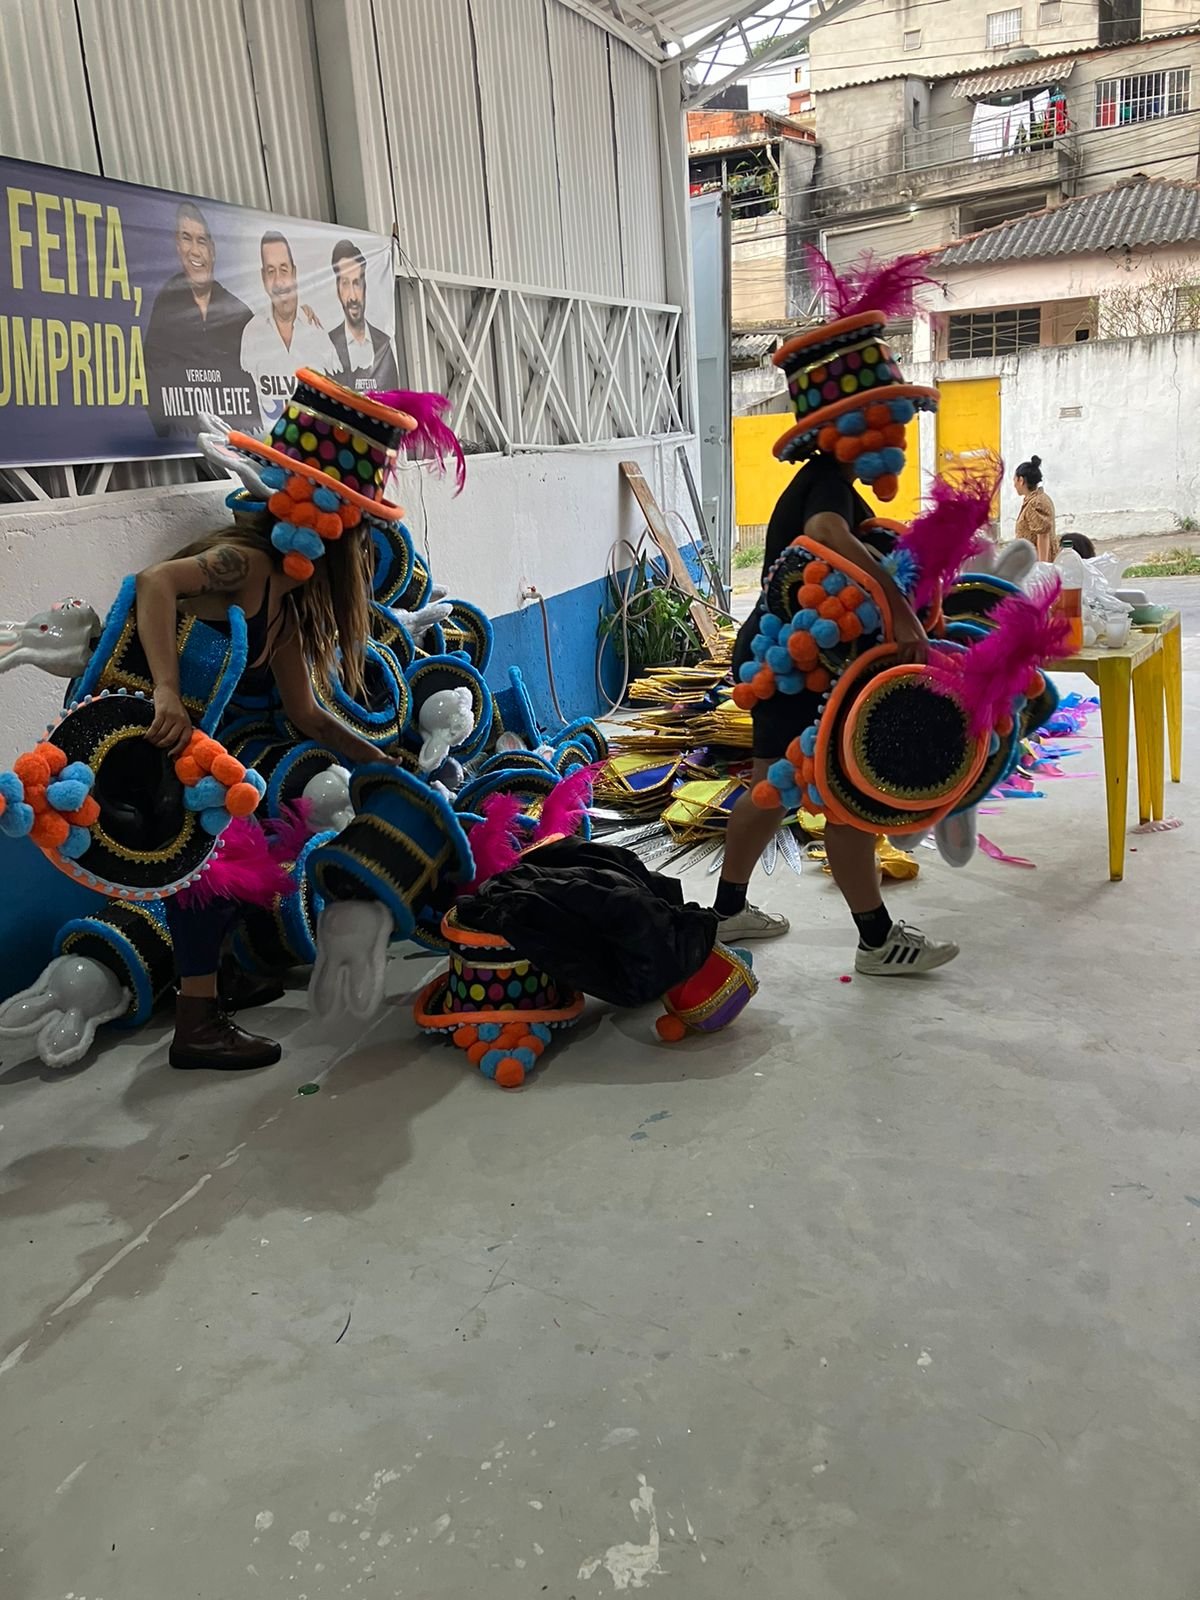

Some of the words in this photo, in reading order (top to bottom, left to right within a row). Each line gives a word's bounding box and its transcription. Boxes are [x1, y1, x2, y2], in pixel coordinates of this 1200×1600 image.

[6, 186, 143, 317] FEITA,
[185, 368, 222, 383] VEREADOR
[161, 386, 215, 417] MILTON
[215, 387, 252, 416] LEITE
